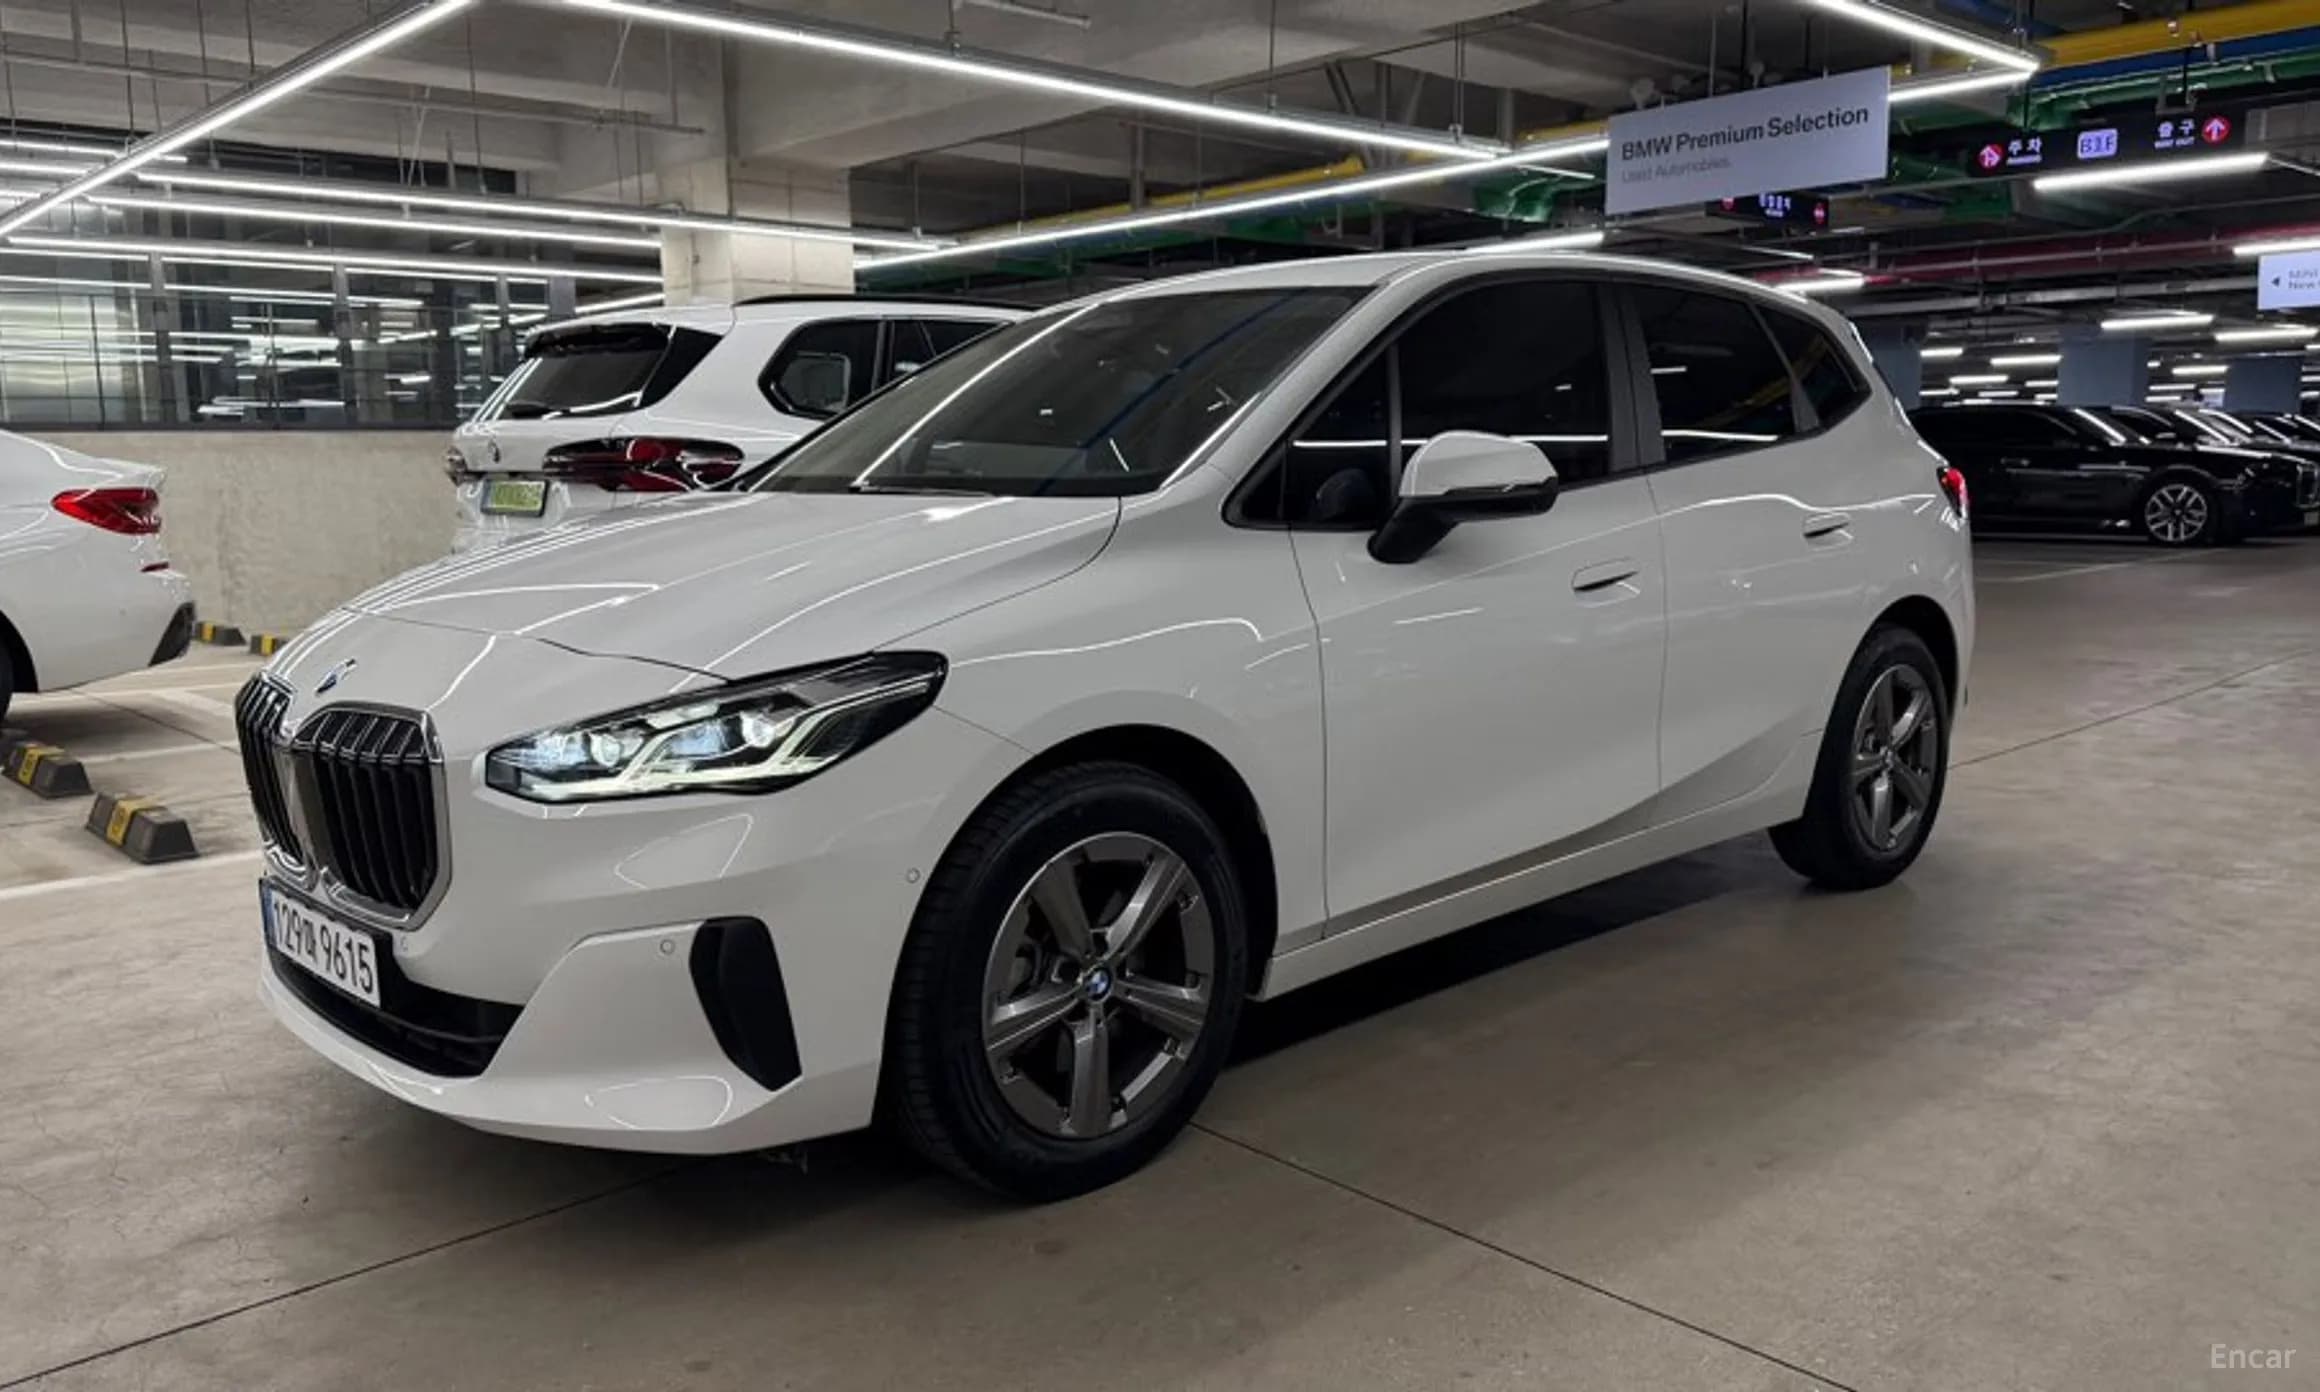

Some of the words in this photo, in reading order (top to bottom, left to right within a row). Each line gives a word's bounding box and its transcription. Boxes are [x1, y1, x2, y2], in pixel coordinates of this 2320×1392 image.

[1621, 135, 1673, 161] BMW
[1676, 124, 1765, 152] Premium
[1767, 106, 1869, 138] Selection
[2080, 136, 2113, 154] B1F
[1621, 168, 1653, 183] Used
[320, 924, 373, 994] 9615
